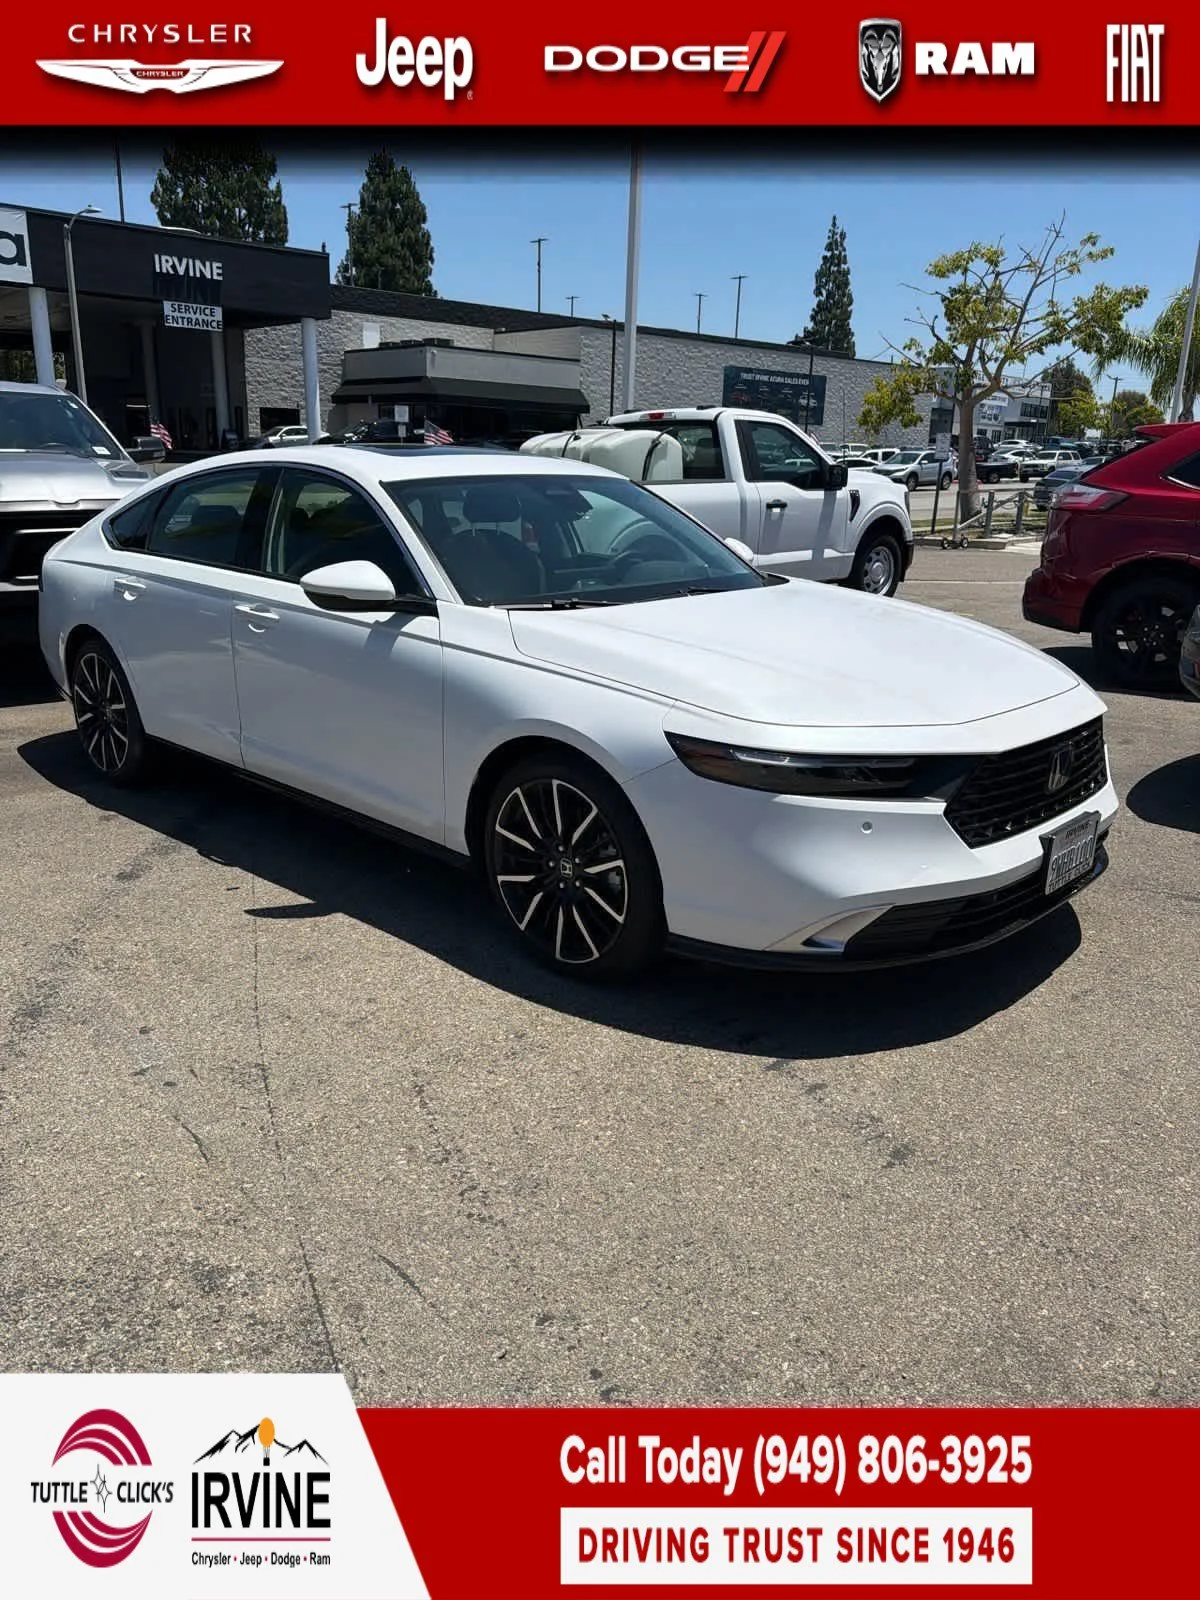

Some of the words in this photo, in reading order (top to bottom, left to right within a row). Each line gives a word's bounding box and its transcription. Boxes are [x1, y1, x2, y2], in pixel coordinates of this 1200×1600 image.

[154, 253, 223, 281] IRVINE
[170, 302, 217, 318] SERVICE
[165, 314, 223, 330] ENTRANCE
